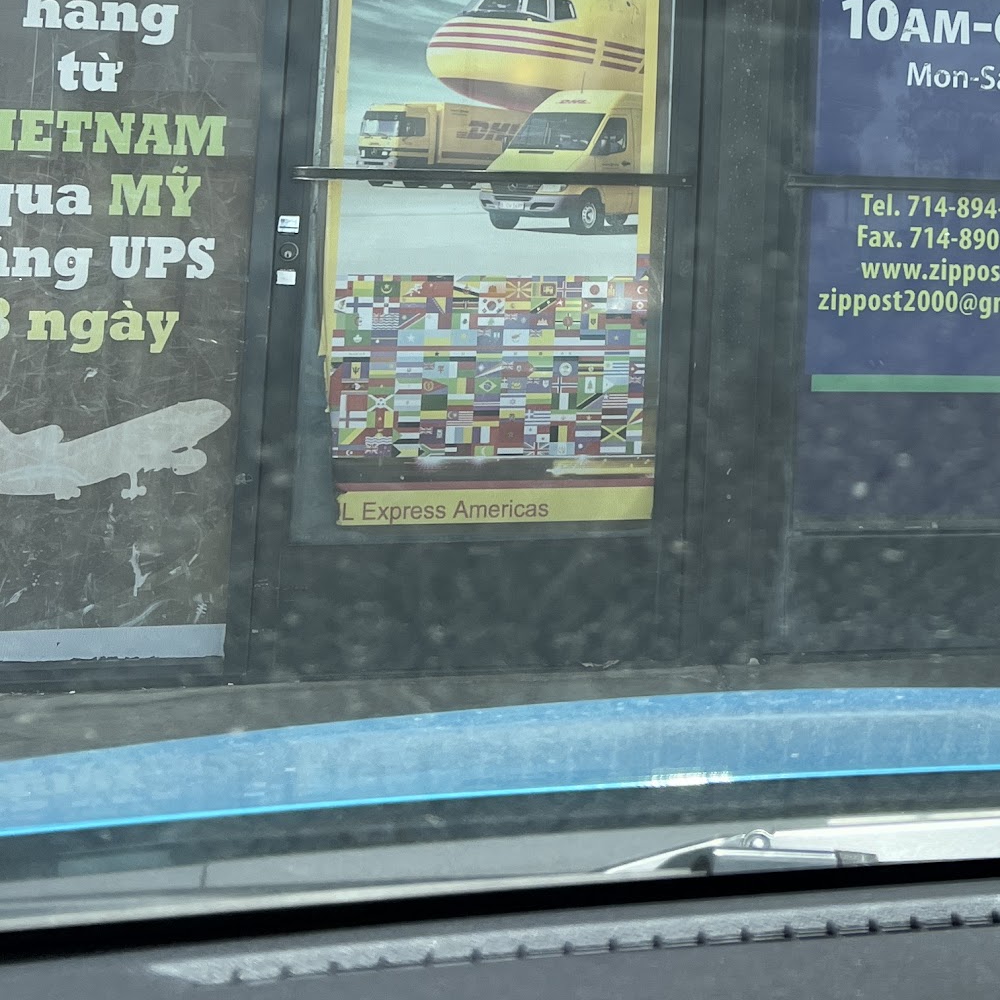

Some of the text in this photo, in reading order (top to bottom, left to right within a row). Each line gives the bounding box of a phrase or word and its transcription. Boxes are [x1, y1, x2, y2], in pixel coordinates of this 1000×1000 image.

[57, 51, 123, 92] từ
[109, 166, 201, 216] MỸ
[861, 193, 900, 217] Tel.
[857, 224, 902, 248] Fax.
[0, 236, 216, 290] ng UPS
[27, 301, 180, 354] ngày
[362, 502, 446, 525] Express
[452, 500, 549, 519] Americas
